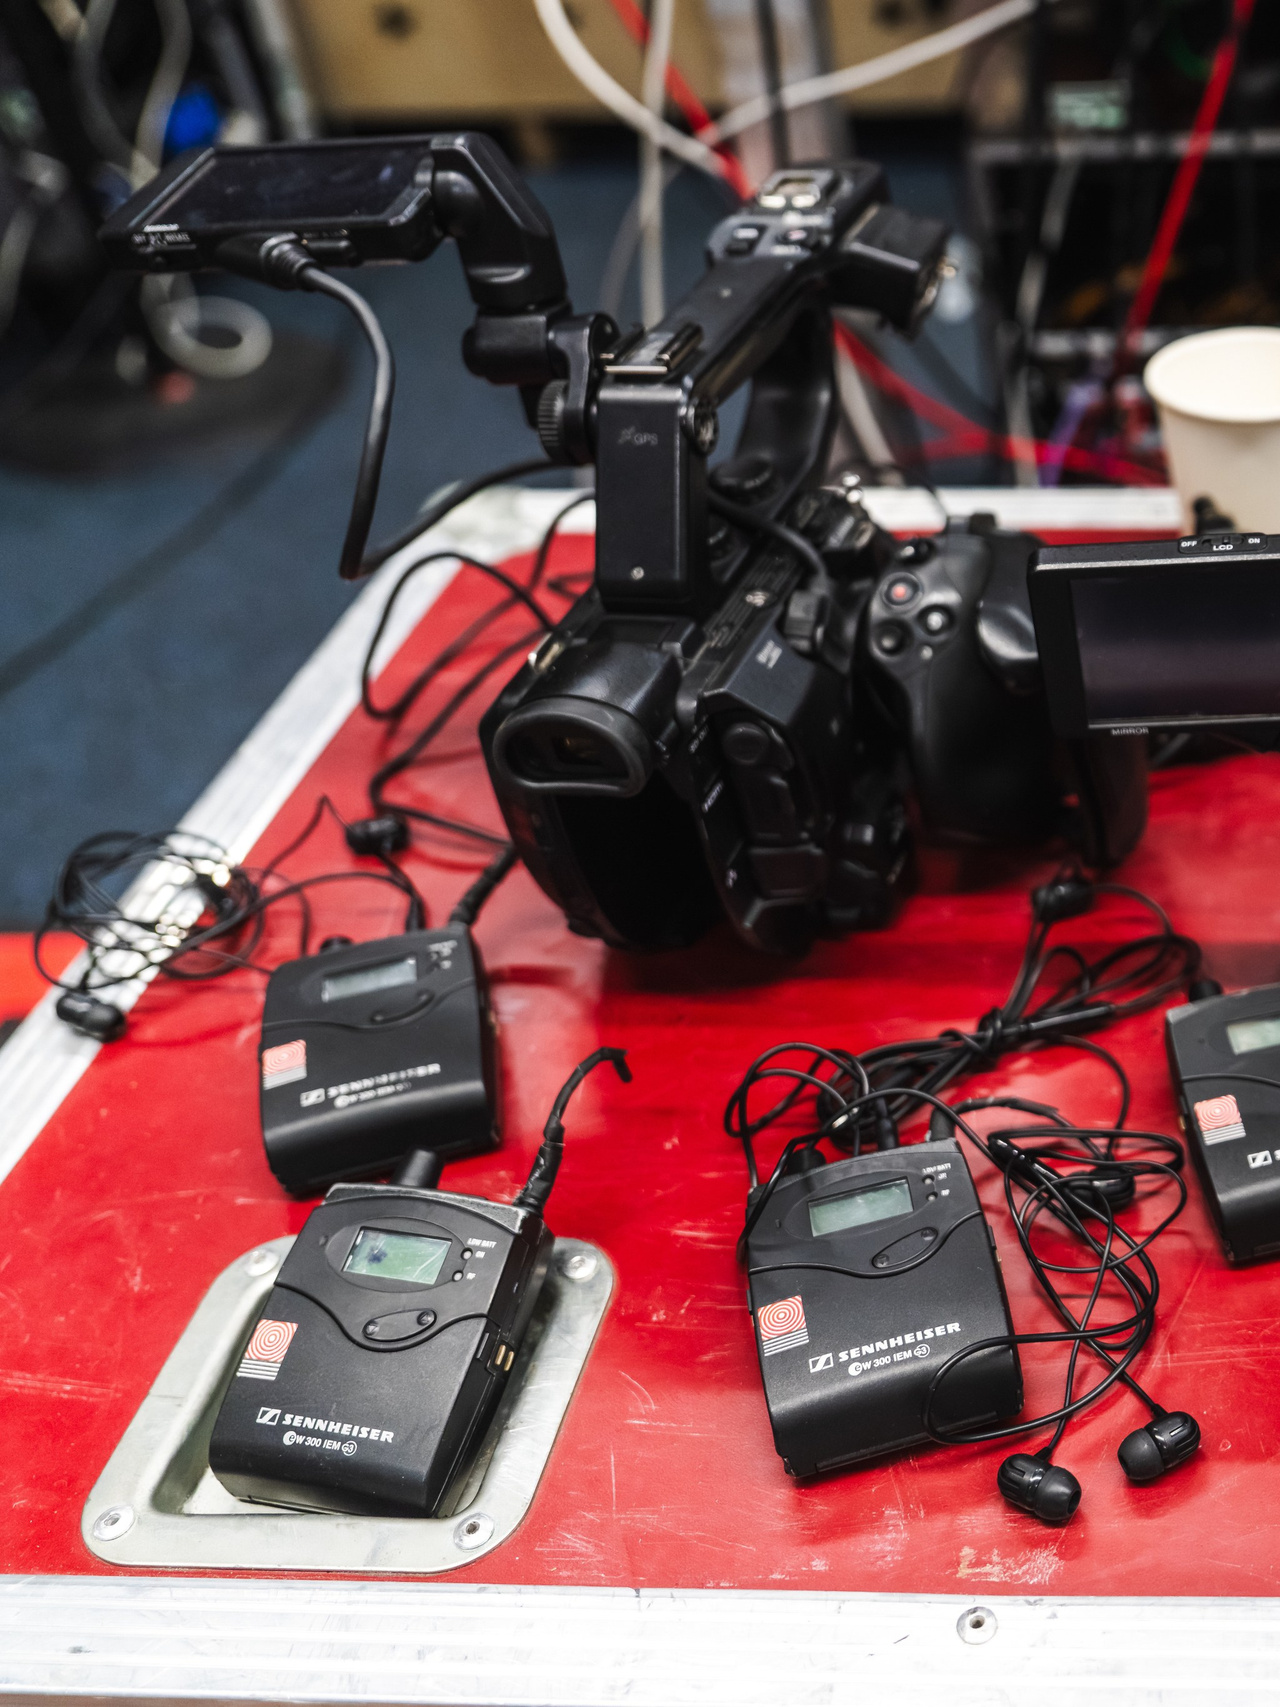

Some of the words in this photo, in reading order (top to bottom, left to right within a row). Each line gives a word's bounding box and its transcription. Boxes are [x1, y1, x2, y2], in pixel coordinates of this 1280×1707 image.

[1111, 727, 1149, 736] MIRROR
[838, 1322, 962, 1362] SENNHEISER
[873, 1355, 892, 1368] 300
[893, 1349, 913, 1362] IEM
[282, 1413, 395, 1443] SENNHEISER
[305, 1436, 322, 1448] 300
[322, 1439, 342, 1451] IEM
[341, 1440, 358, 1456] G3
